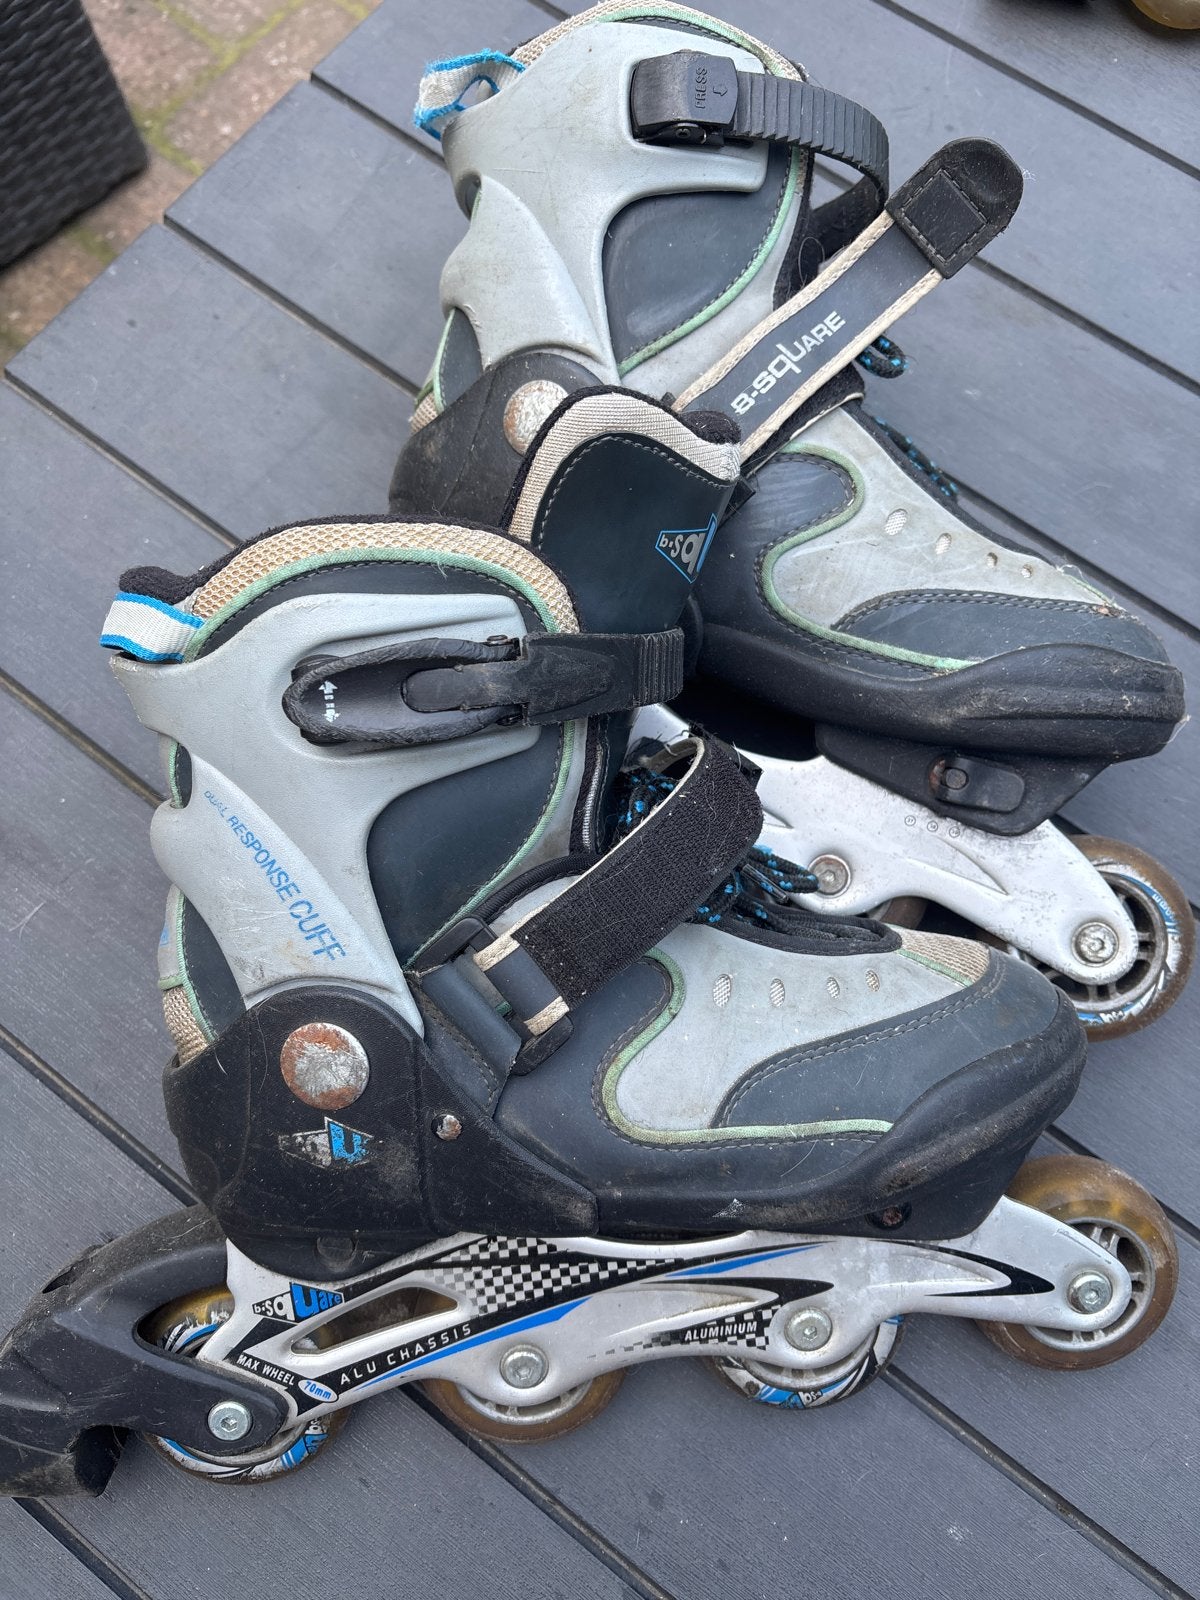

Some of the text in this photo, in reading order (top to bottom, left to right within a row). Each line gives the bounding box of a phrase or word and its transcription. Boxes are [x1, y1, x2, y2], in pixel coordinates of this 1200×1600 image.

[695, 67, 707, 109] PRESS
[227, 815, 302, 901] RESPONSE
[288, 900, 346, 960] CUFF
[341, 1323, 472, 1385] ALU CHASSIS
[684, 1321, 757, 1341] ALUMINIUM
[237, 1354, 331, 1400] MAX WHEEL 70mm
